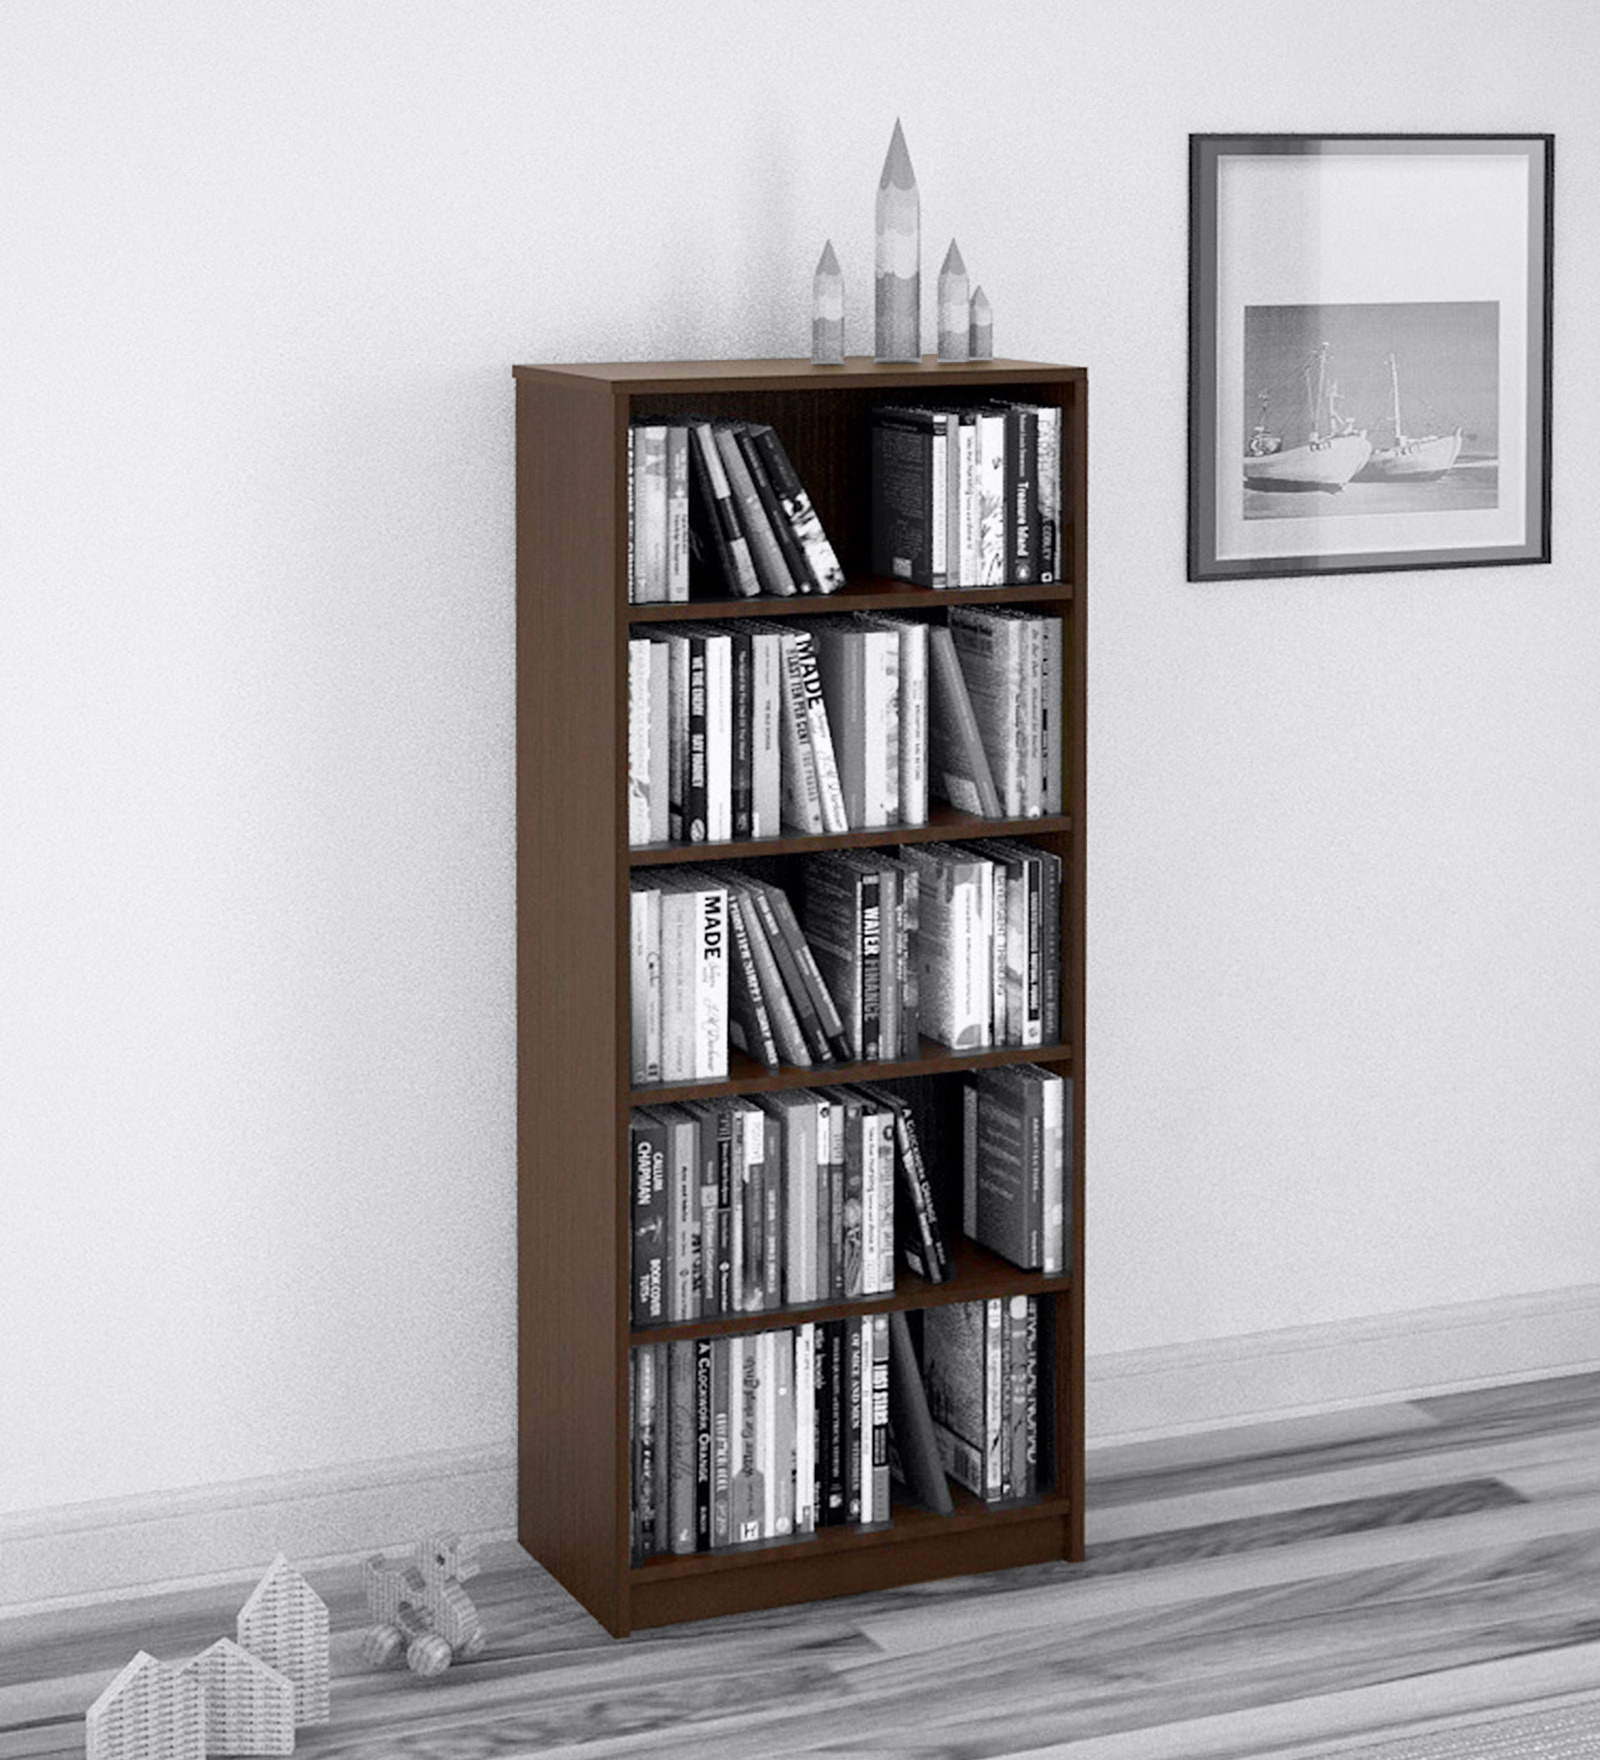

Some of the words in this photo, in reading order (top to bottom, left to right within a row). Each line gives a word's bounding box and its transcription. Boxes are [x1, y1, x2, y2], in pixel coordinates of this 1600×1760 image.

[1017, 482, 1029, 524] Treasure
[1017, 526, 1029, 556] Island
[787, 655, 801, 681] LAST
[796, 640, 823, 711] MADE
[790, 682, 805, 700] TEN
[793, 702, 807, 719] PER
[795, 721, 810, 745] CENT
[704, 896, 721, 960] MADE
[864, 906, 880, 956] WATER
[864, 957, 879, 1022] FINANCE
[637, 1142, 651, 1206] CHAPMAN
[652, 1152, 664, 1192] CALLUM
[903, 1109, 912, 1118] A
[921, 1181, 938, 1224] ORANGE
[651, 1288, 661, 1317] COVER
[699, 1343, 710, 1354] A
[851, 1333, 860, 1348] OF
[851, 1350, 860, 1378] MICE
[698, 1357, 710, 1430] CLOCKWORK
[851, 1379, 860, 1403] AND
[851, 1404, 860, 1429] MEN
[698, 1433, 710, 1483] ORANGE
